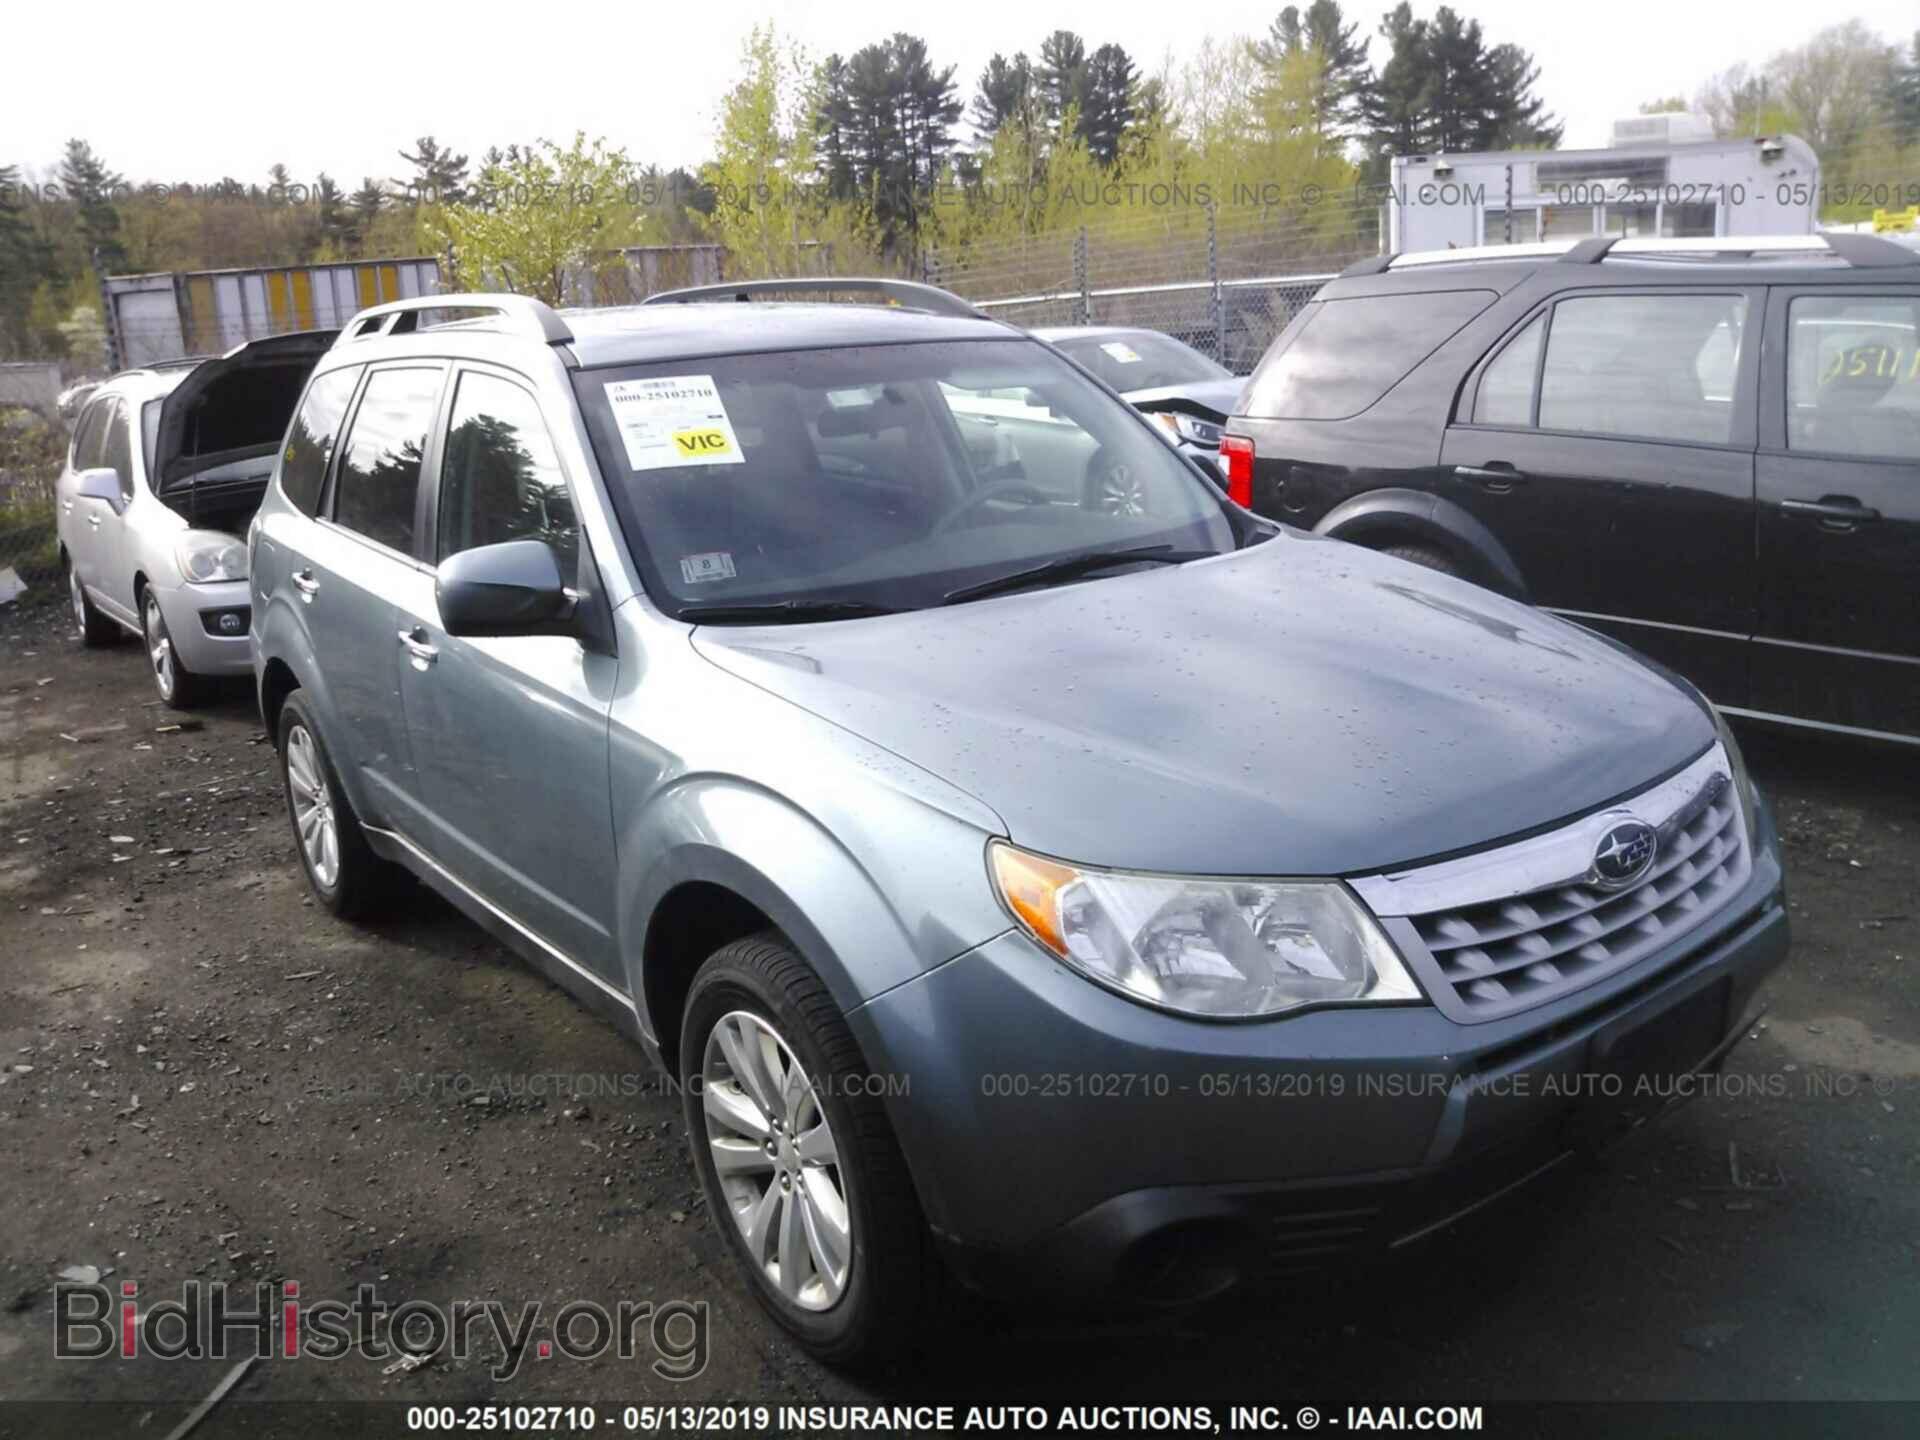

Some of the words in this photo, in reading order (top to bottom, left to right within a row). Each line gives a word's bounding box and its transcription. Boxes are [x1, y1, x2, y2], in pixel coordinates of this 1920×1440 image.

[614, 388, 713, 403] 000-25102710
[677, 433, 726, 451] VIC
[702, 559, 712, 570] 8
